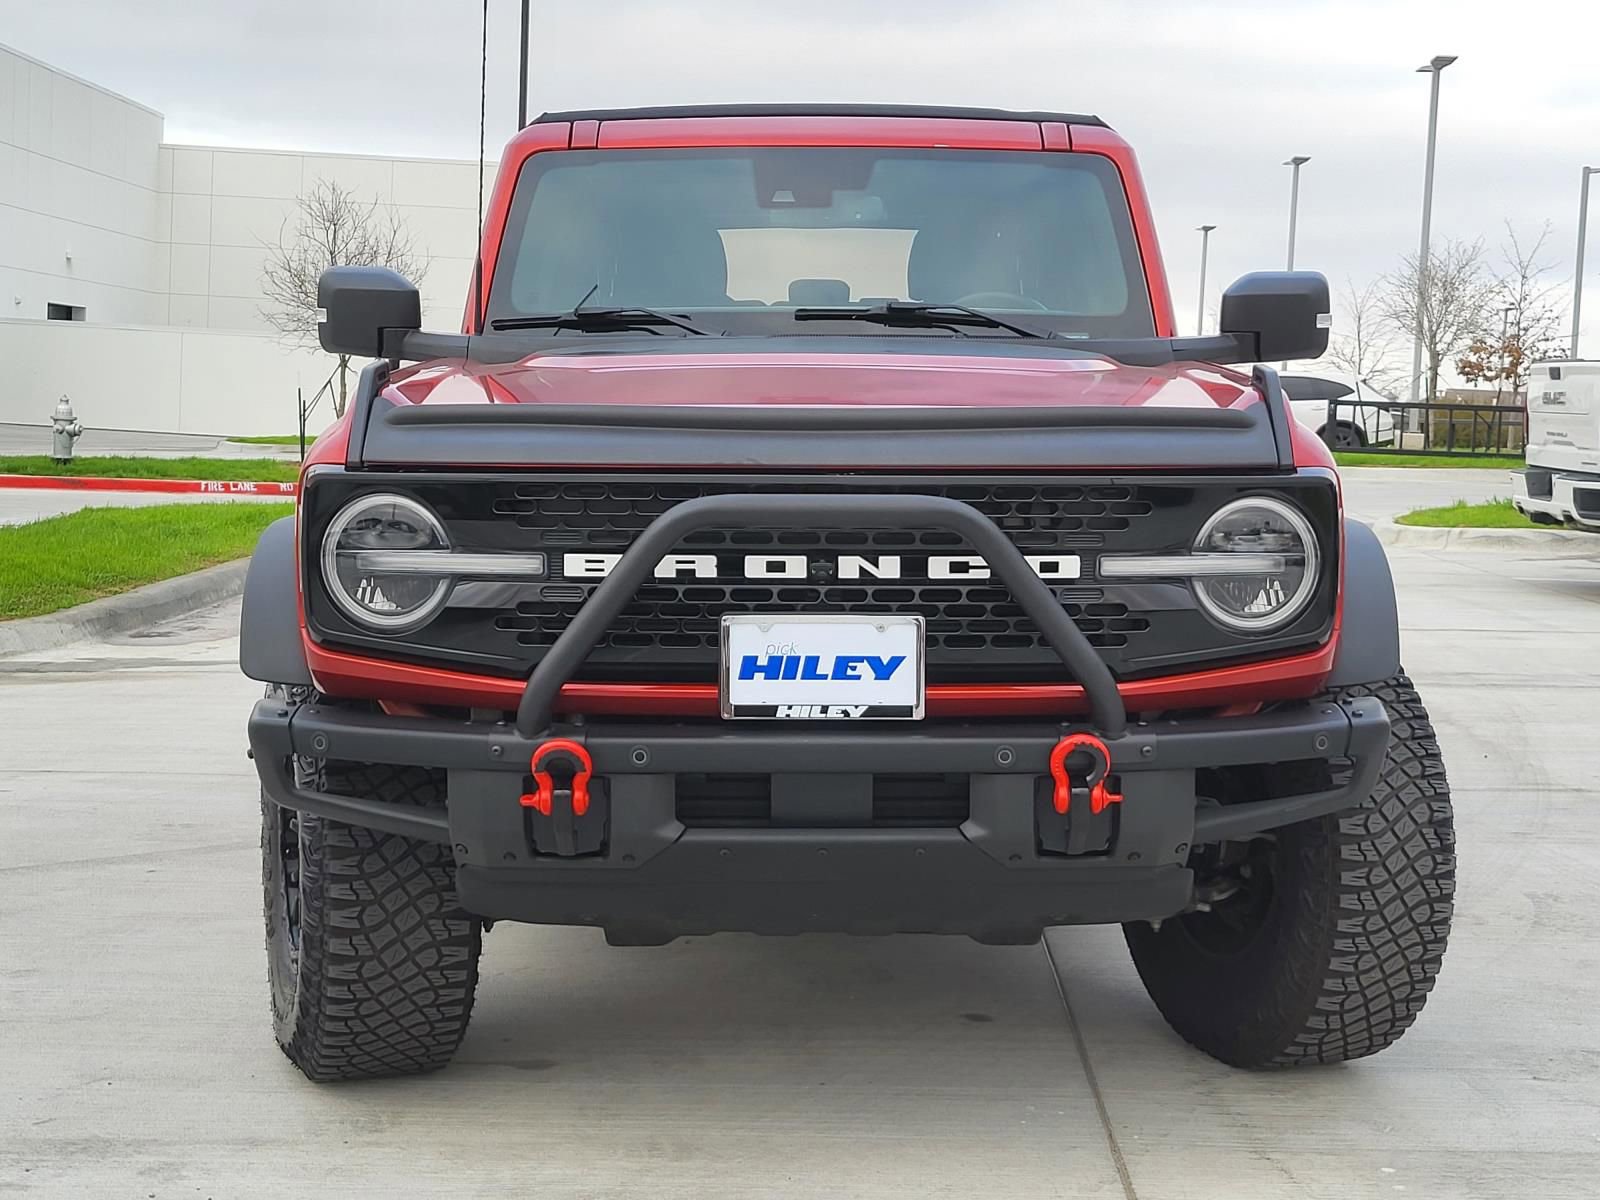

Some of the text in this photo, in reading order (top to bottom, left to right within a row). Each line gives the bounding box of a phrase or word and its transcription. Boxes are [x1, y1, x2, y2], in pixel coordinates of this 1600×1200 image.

[200, 481, 294, 492] FIRE LANE NO
[563, 553, 1081, 579] BRONCO
[765, 641, 800, 657] pick
[737, 655, 907, 681] HILEY
[775, 705, 869, 719] HILEY
